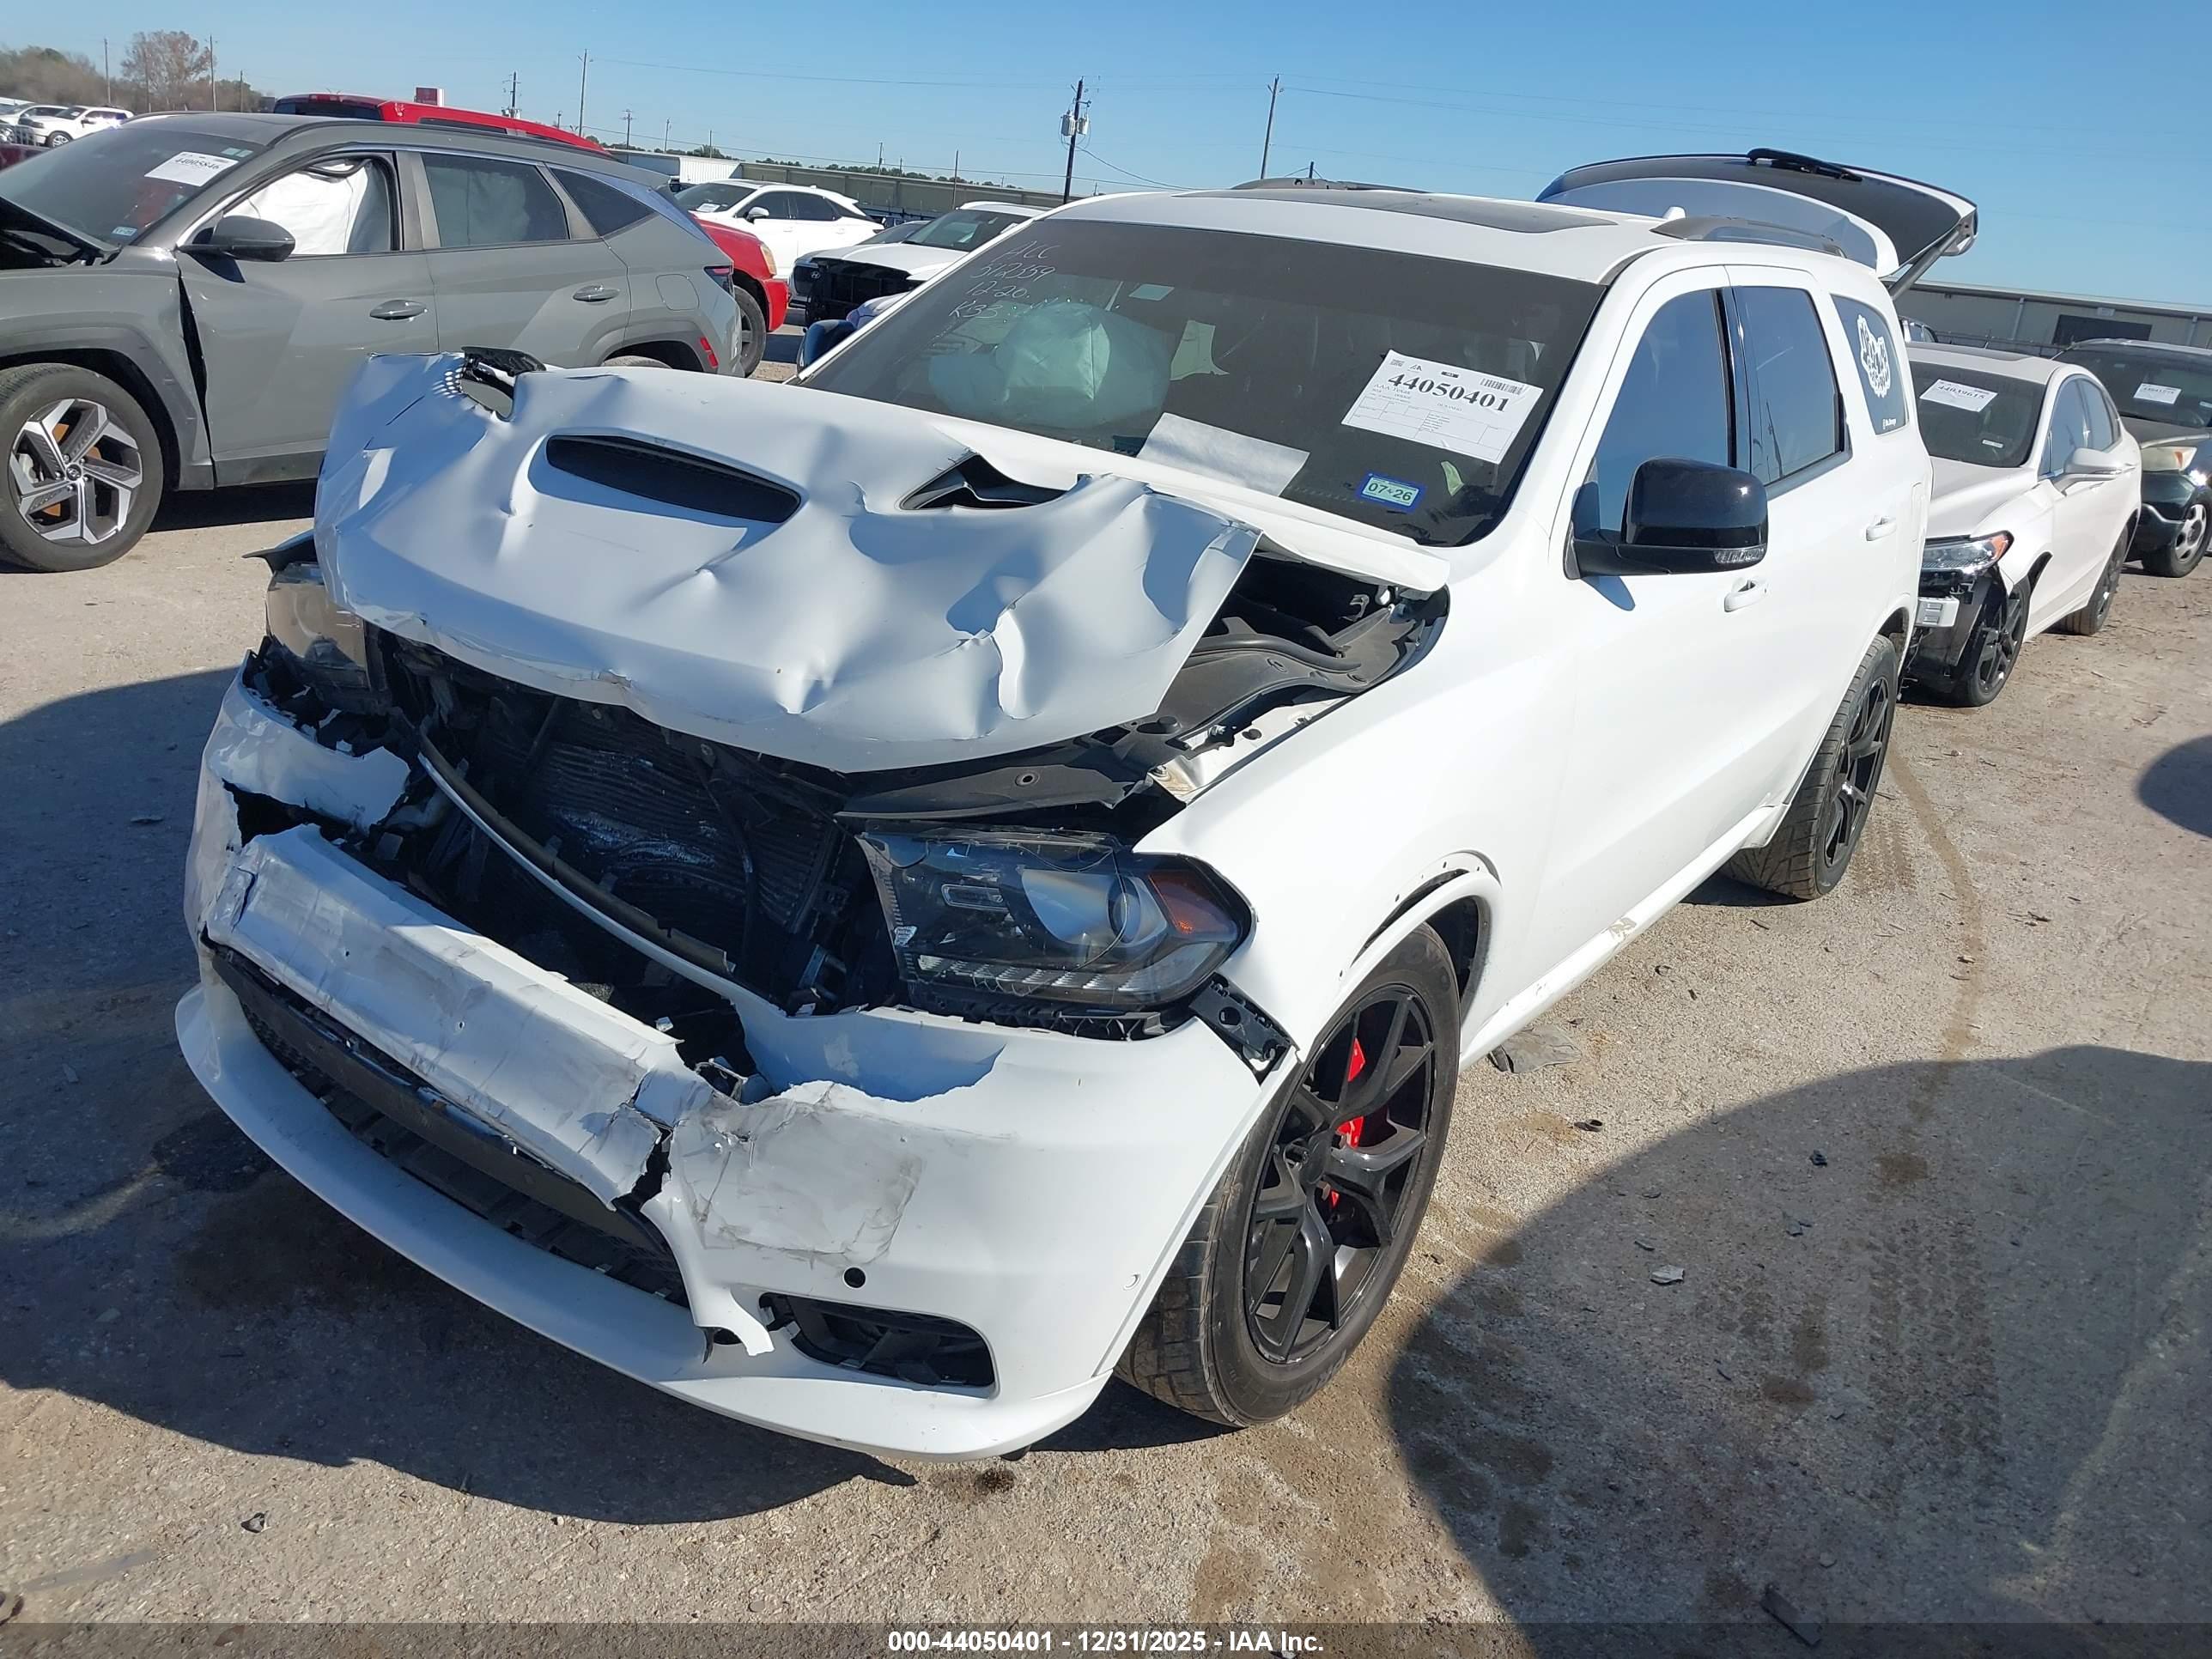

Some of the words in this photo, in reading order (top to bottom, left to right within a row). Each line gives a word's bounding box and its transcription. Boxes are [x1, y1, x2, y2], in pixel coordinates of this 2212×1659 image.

[1388, 373, 1510, 413] 44050401
[1368, 482, 1389, 494] 07
[1392, 489, 1413, 501] 26
